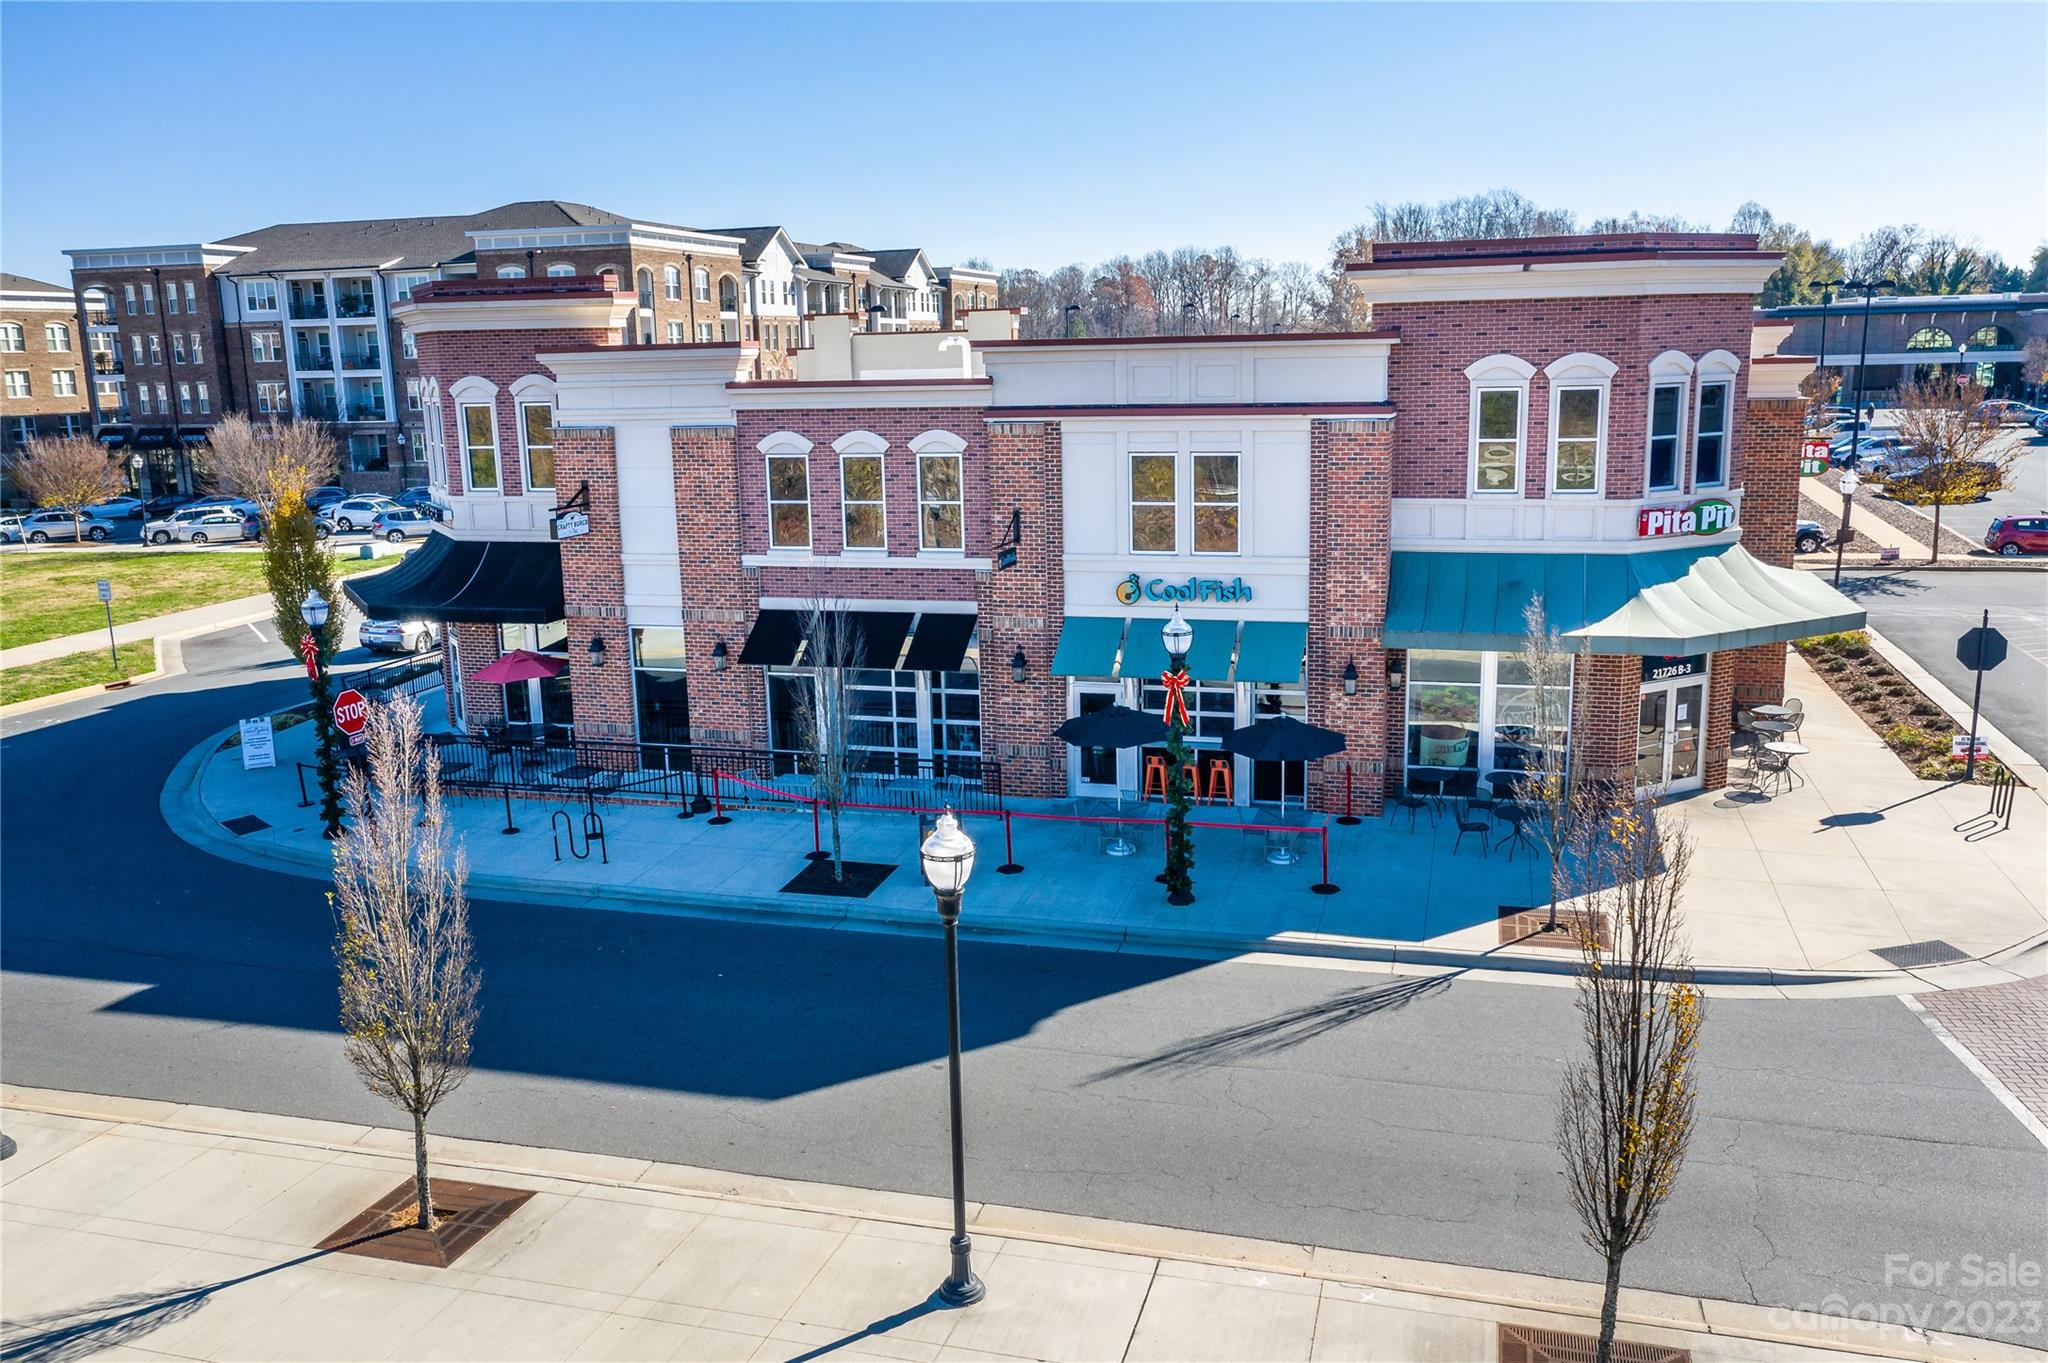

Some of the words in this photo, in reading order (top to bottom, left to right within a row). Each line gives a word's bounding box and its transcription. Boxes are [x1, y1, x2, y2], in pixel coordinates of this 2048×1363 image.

[1801, 443, 1828, 458] ita
[1800, 459, 1821, 473] it
[1647, 509, 1696, 536] Pita
[1700, 504, 1735, 530] Pit
[1652, 665, 1678, 679] 21726
[1678, 663, 1692, 675] B-3
[337, 701, 366, 724] STOP
